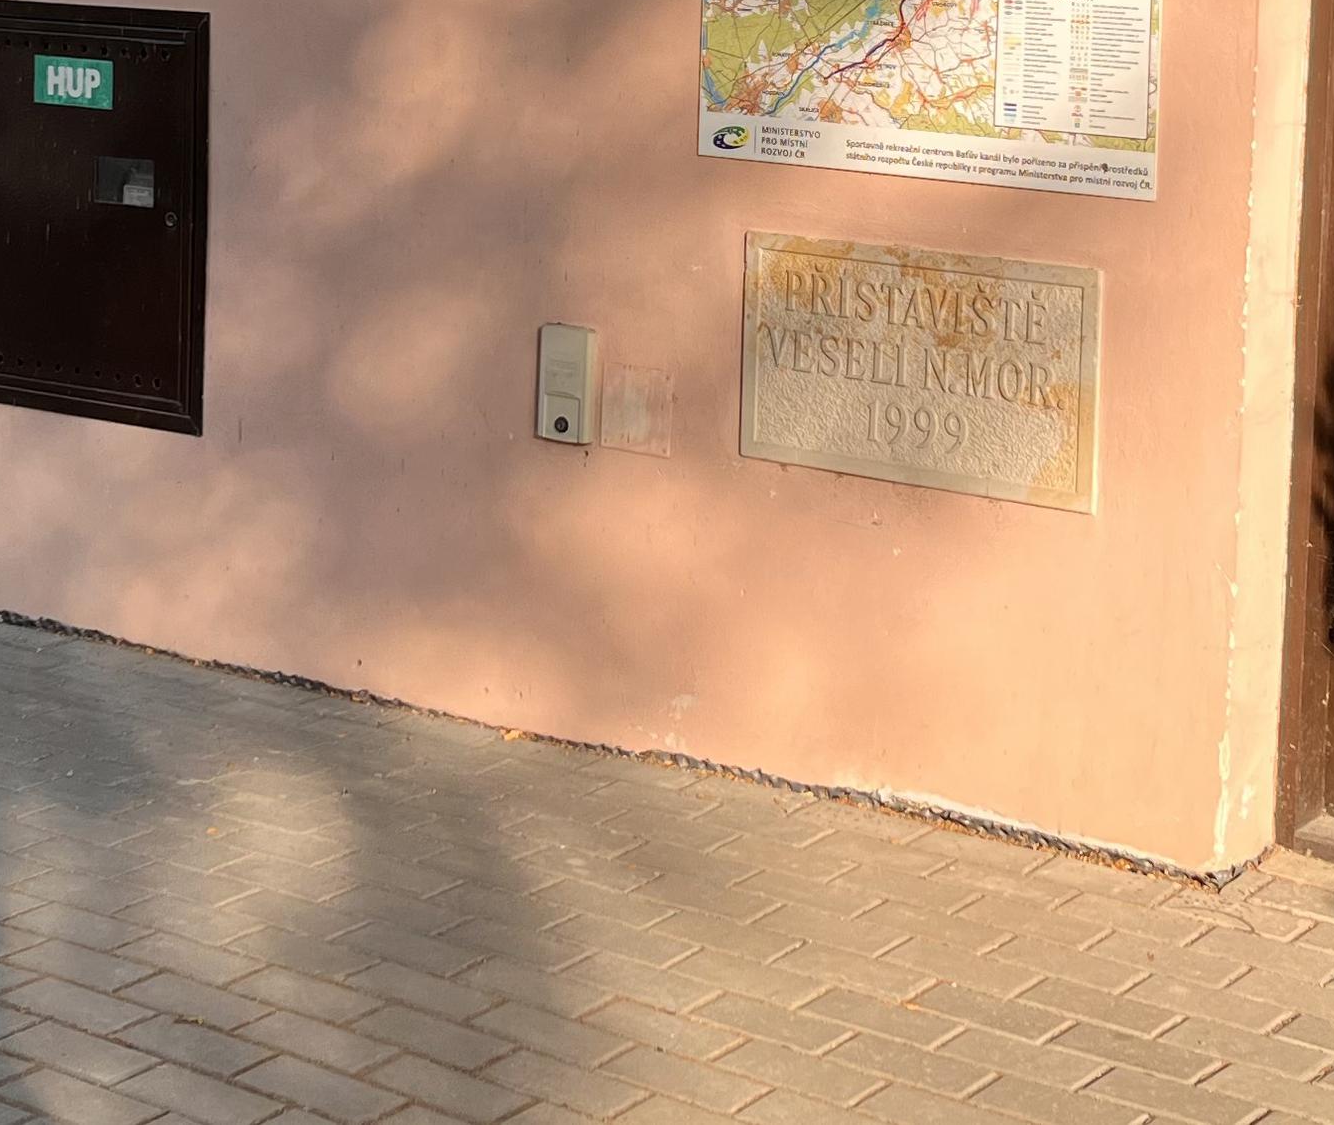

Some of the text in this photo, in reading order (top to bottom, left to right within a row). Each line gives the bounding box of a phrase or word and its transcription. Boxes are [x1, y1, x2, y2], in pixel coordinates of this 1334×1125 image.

[46, 65, 101, 99] HUP
[761, 126, 821, 139] MINISTERSTVO
[761, 137, 809, 148] PRO MÍSTNÍ
[760, 147, 805, 158] ROZVOJ ČR
[845, 139, 885, 152] Sportovně
[885, 143, 921, 154] rekreační
[922, 147, 954, 157] centrum
[955, 149, 979, 160] Baťův
[980, 151, 1001, 163] kanál
[1002, 153, 1019, 165] bylo
[1021, 156, 1056, 169] pořízeno
[845, 152, 875, 162] státního
[877, 154, 910, 165] rozpočtu
[911, 157, 933, 167] České
[935, 161, 972, 173] republiky
[978, 166, 1017, 177] programu
[1018, 168, 1068, 181] Ministerstva
[1069, 175, 1084, 184] pro
[1085, 176, 1111, 186] místní
[1112, 180, 1137, 190] rozvoj
[784, 263, 1049, 347] PŘÍSTAVIŠTĚ
[763, 327, 909, 389] VESELÍ
[866, 401, 968, 455] 1999
